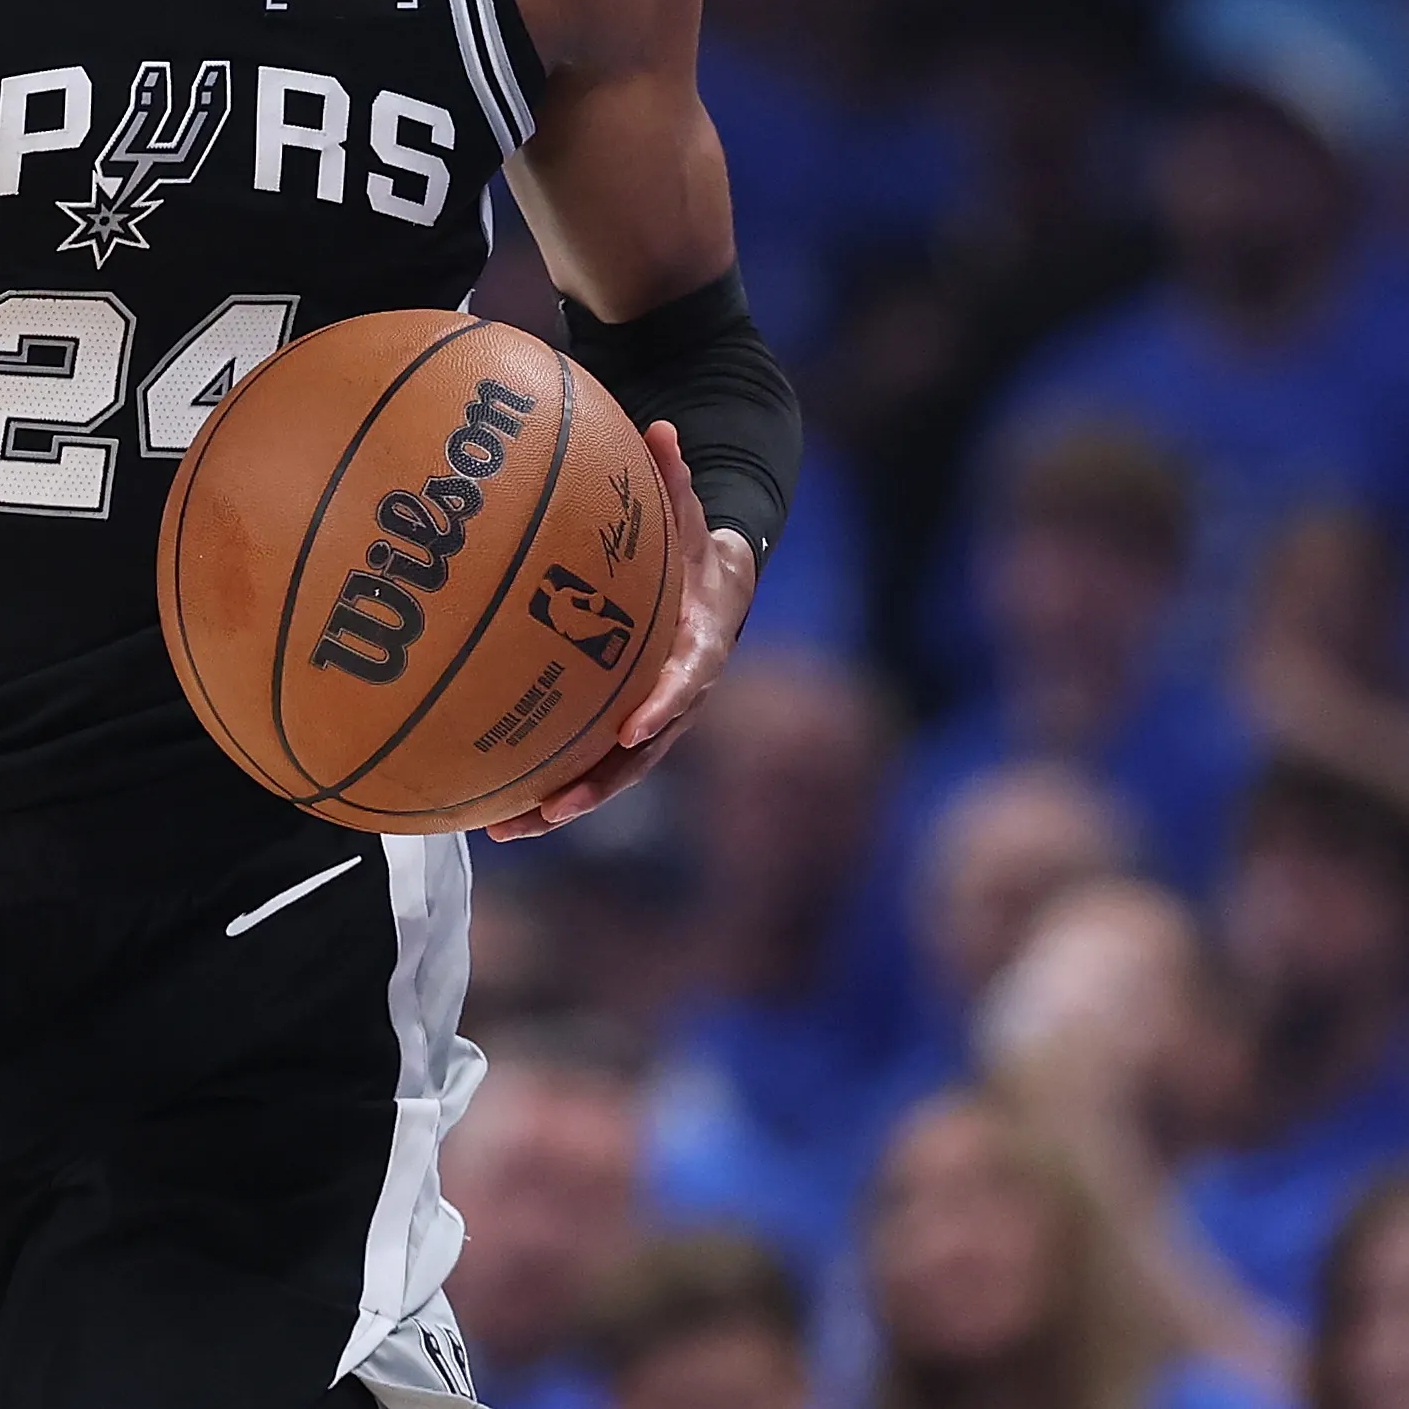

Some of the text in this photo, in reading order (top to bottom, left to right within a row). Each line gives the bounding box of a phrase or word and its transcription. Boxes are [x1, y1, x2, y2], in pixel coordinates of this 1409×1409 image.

[310, 378, 537, 685] Wilson
[472, 660, 566, 753] OFFICIAL GAME BALL
